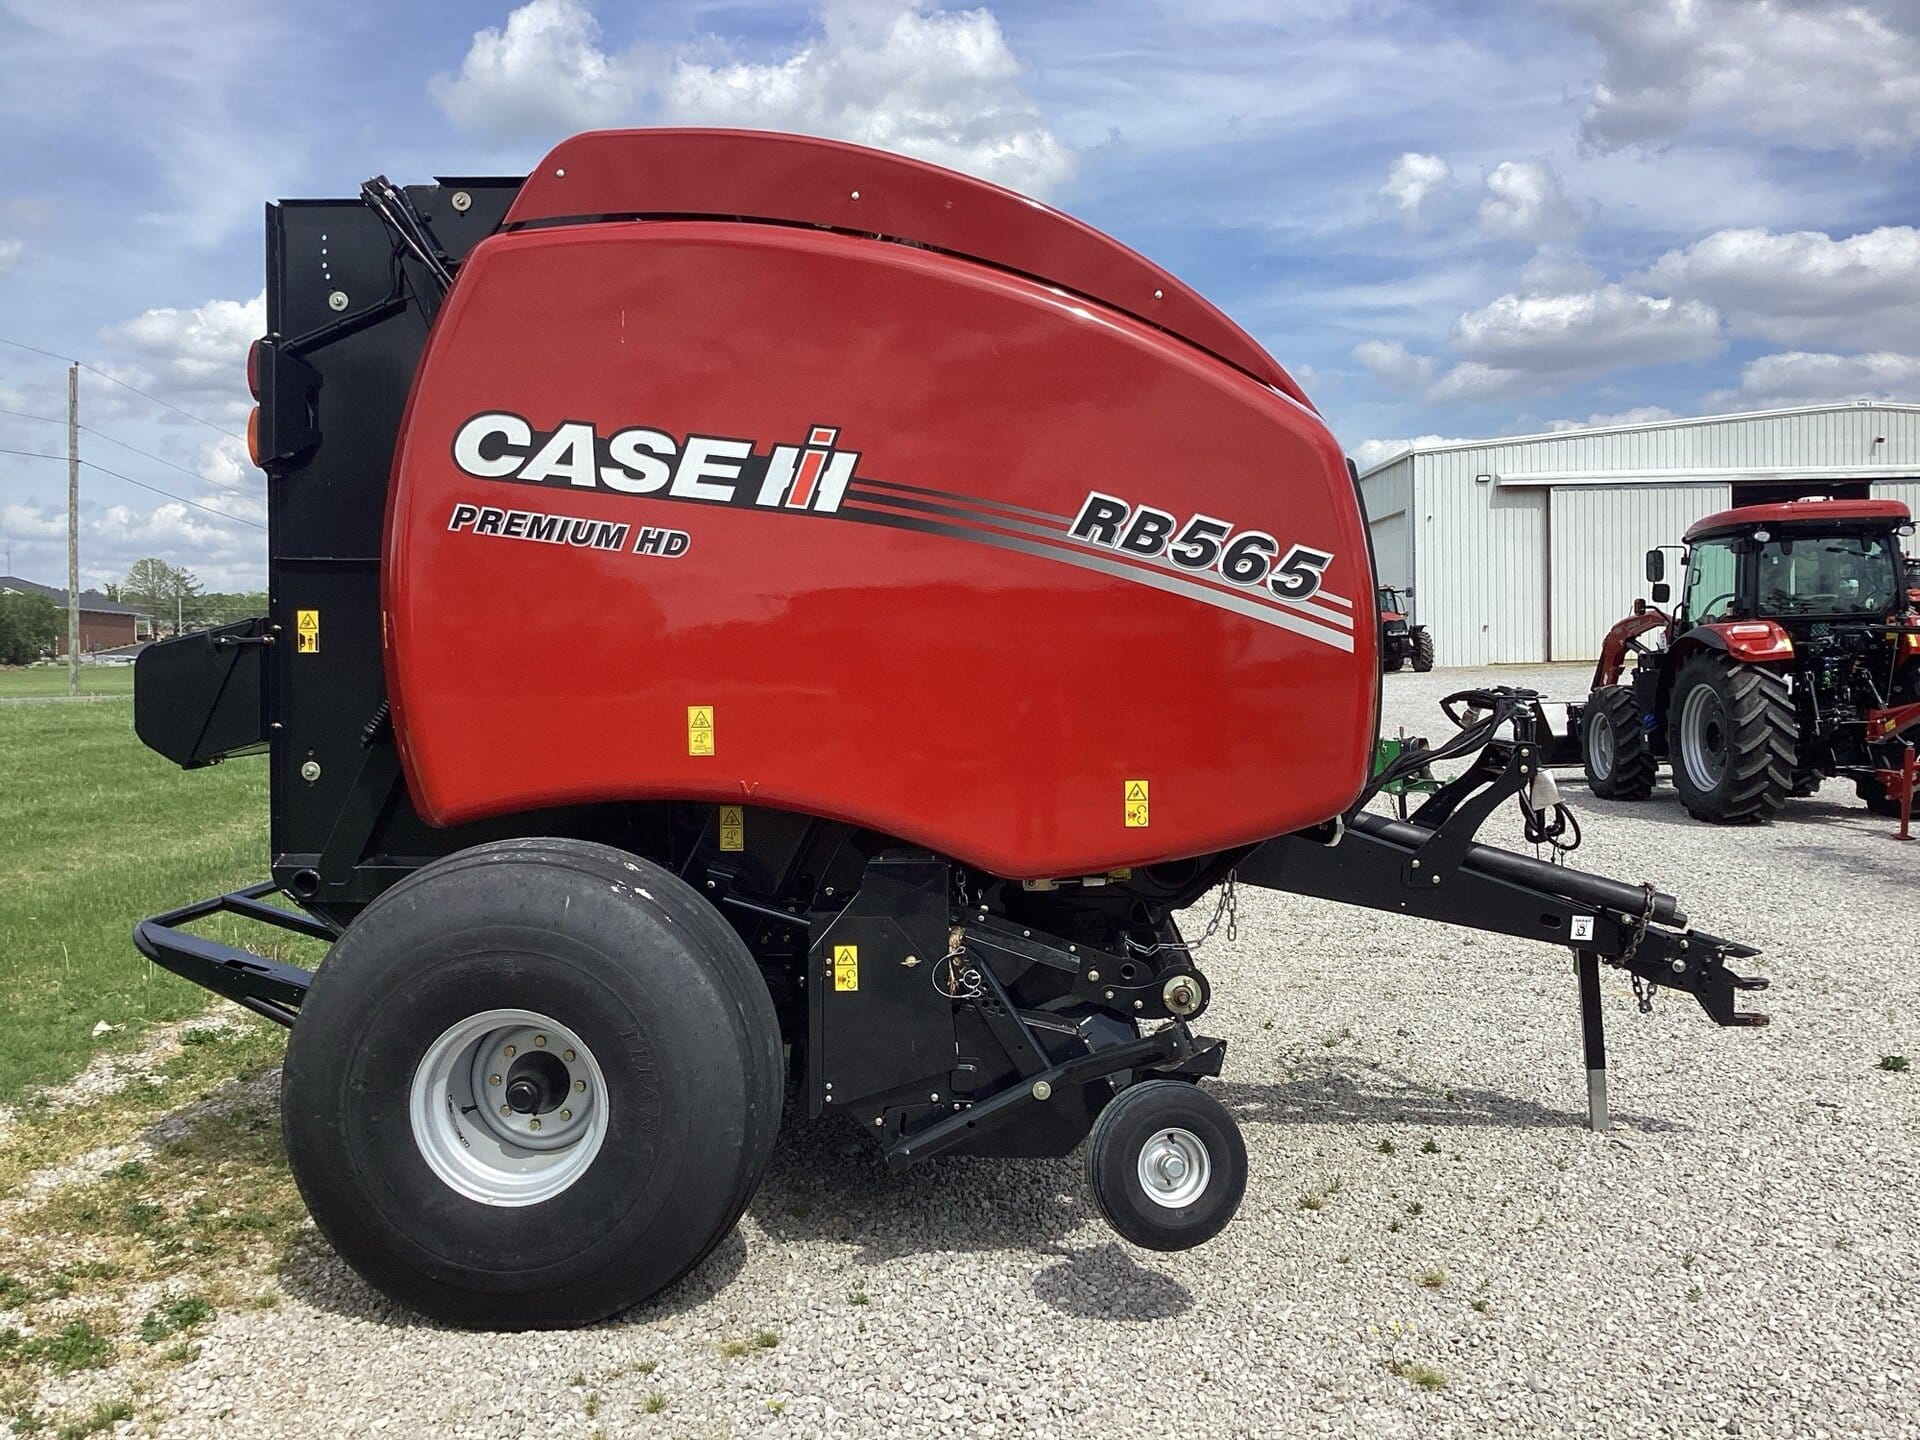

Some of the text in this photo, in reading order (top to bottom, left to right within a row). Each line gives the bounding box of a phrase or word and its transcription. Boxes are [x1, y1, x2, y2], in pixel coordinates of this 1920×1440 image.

[453, 411, 753, 503] CASE
[447, 503, 691, 558] PREMIUM HD
[1067, 490, 1335, 602] RB565
